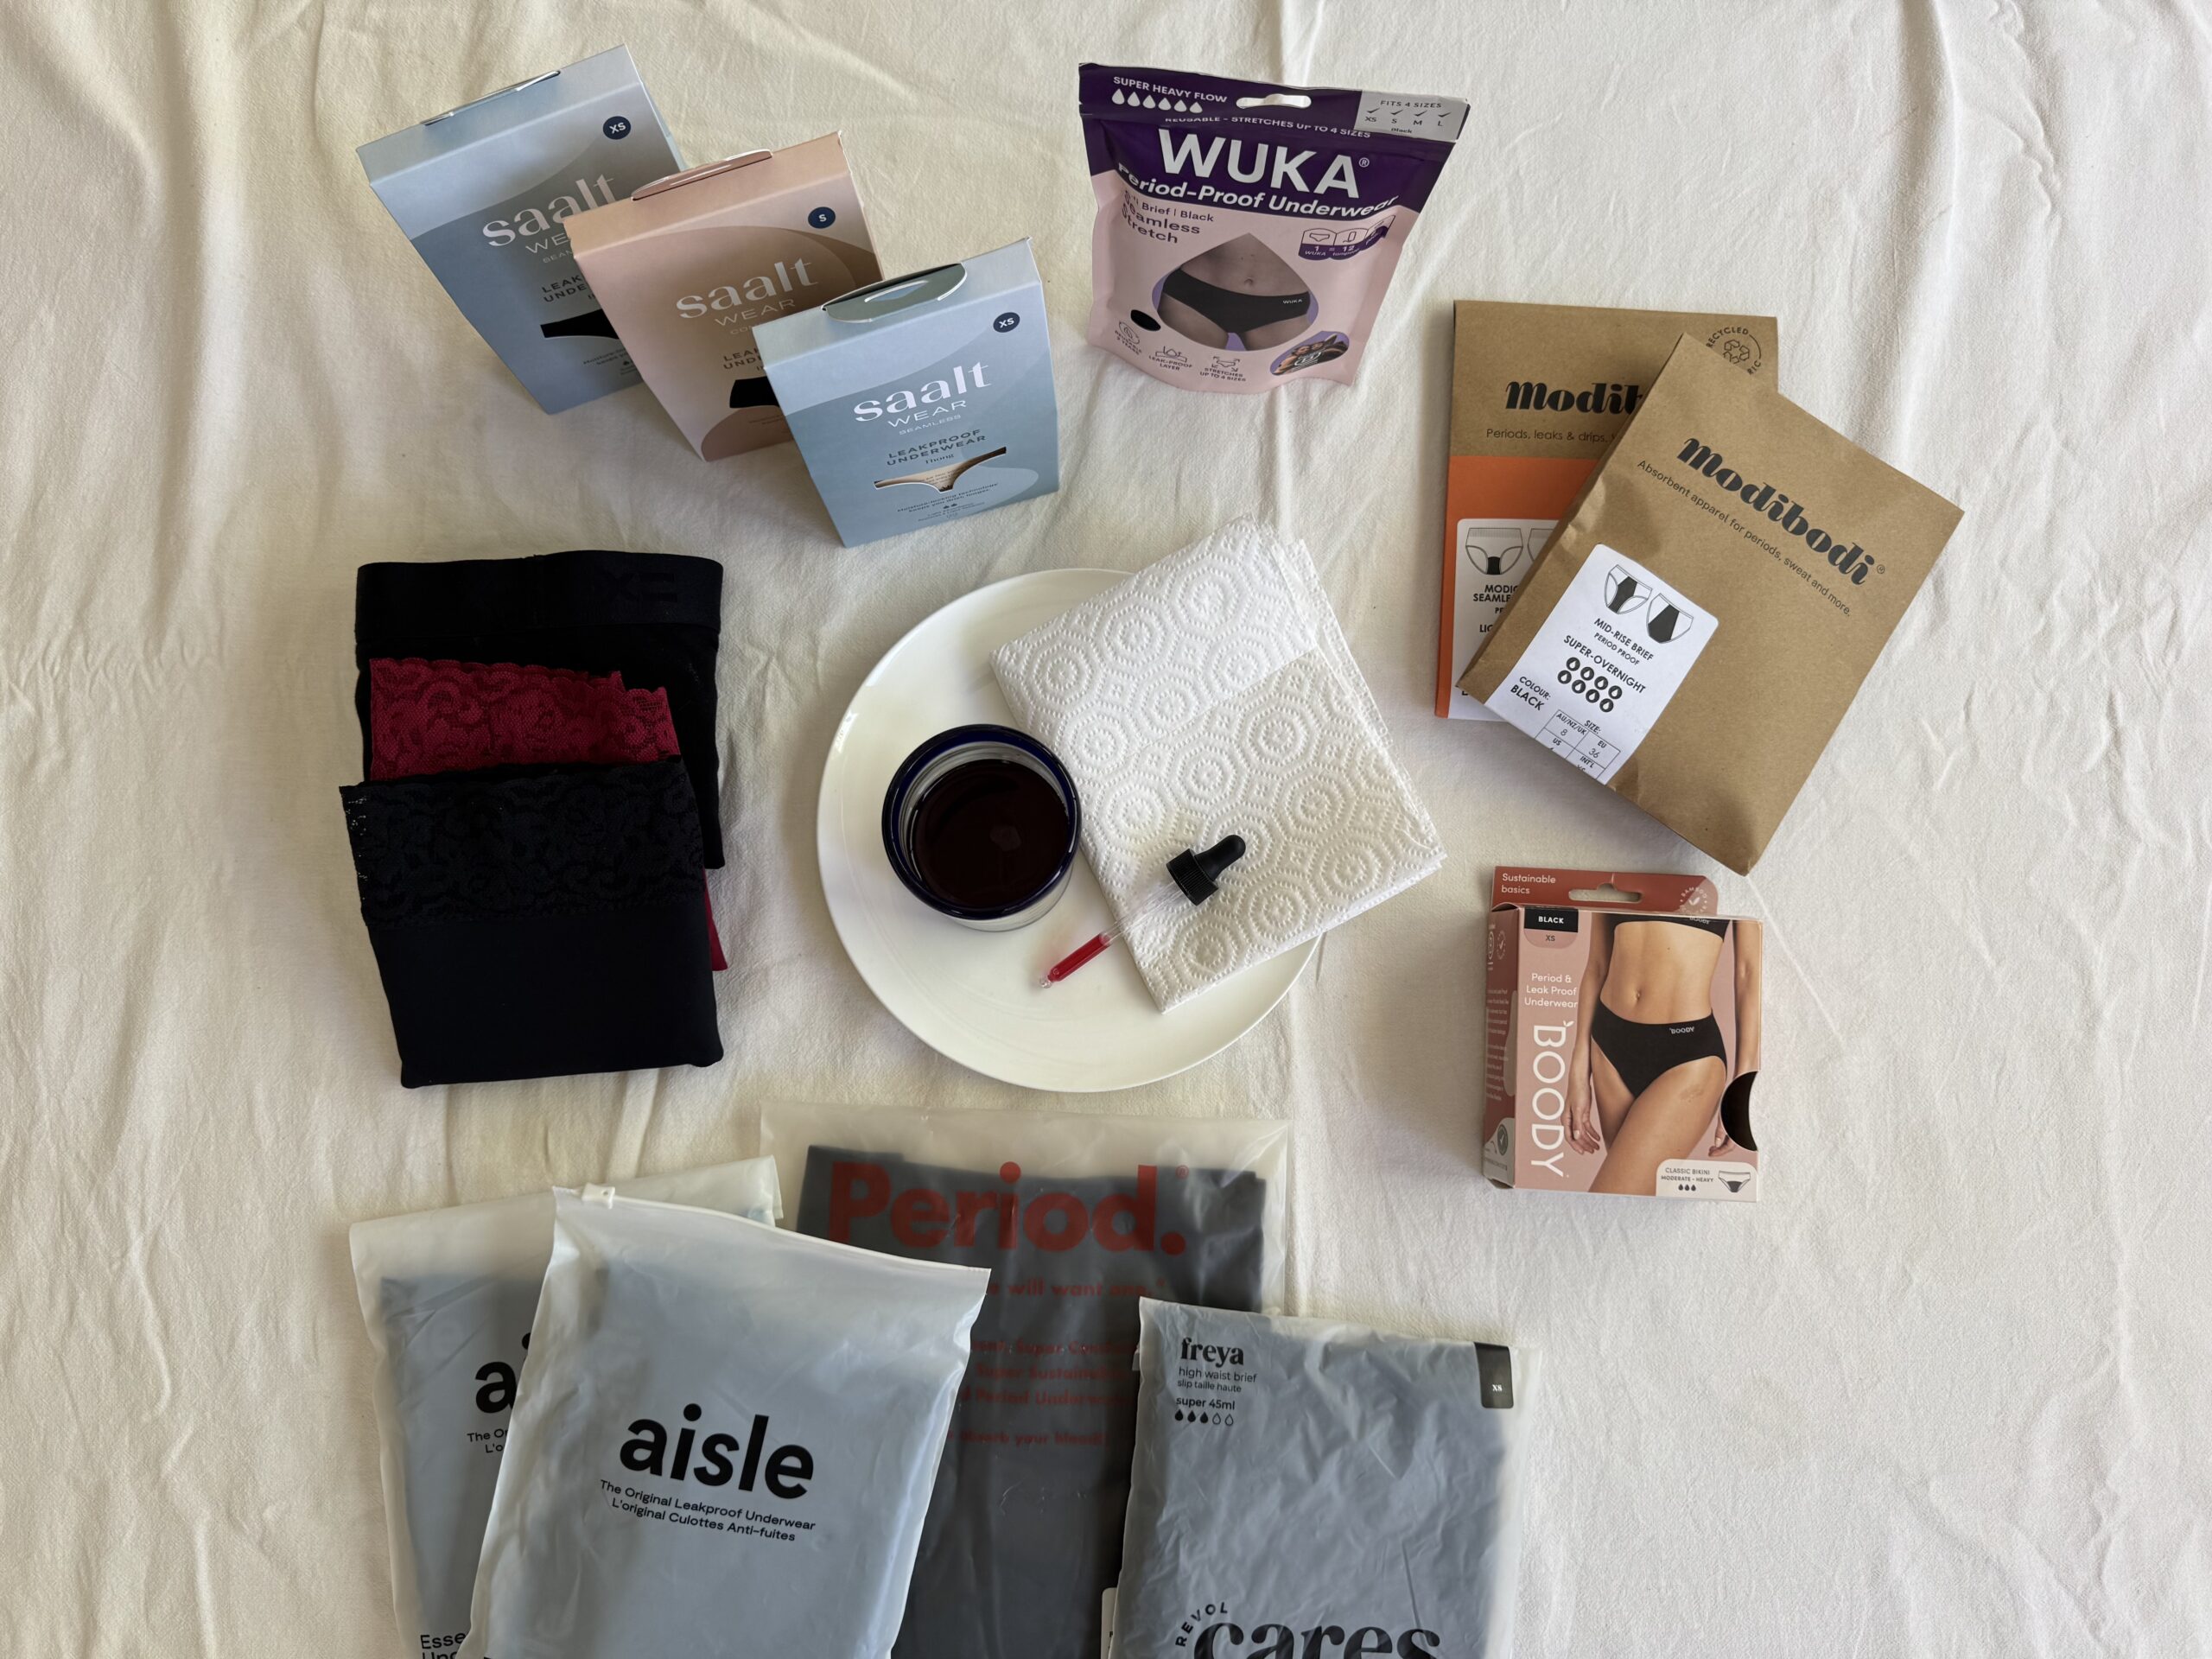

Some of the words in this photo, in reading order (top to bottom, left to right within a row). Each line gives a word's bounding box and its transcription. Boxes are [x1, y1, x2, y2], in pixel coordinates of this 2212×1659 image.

[1113, 76, 1150, 91] SUPER
[1153, 84, 1192, 99] HEAVY
[1194, 92, 1228, 103] FLOW
[609, 121, 626, 135] XS
[1231, 117, 1294, 129] STRETCHES
[1314, 124, 1328, 133] TO
[1340, 129, 1371, 139] SIZES
[482, 174, 616, 247] saalt
[1142, 202, 1172, 215] Brief
[1180, 210, 1214, 222] Black
[1268, 194, 1400, 218] Underwear
[819, 213, 827, 222] S
[676, 257, 818, 319] saalt
[714, 298, 795, 327] WEAR
[999, 317, 1014, 328] XS
[1706, 327, 1750, 348] RECYCLED
[853, 361, 992, 422] saalt
[887, 399, 967, 428] WEAR
[888, 429, 982, 459] LEAKPROOF
[1486, 428, 1531, 441] Periods,
[1534, 429, 1563, 441] leaks
[1567, 431, 1575, 441] &
[1578, 430, 1608, 446] drips.
[887, 435, 987, 466] UNDERWEAR
[1637, 460, 1690, 499] Absorbent
[1690, 492, 1731, 524] apparel
[1729, 518, 1745, 533] for
[1743, 531, 1782, 562] periods,
[1783, 557, 1811, 582] sweat
[1810, 579, 1829, 596] and
[1827, 594, 1851, 617] more.
[1593, 618, 1632, 647] MID-RISE
[1630, 642, 1654, 661] BRIEF
[1593, 632, 1618, 652] PERIOD
[1617, 646, 1640, 666] PROOF
[1563, 634, 1647, 694] SUPER-OVERNIGHT
[1510, 684, 1545, 711] BLACK
[1519, 676, 1552, 701] COLOUR:
[1556, 713, 1587, 735] AU/NZ/UK
[1560, 728, 1568, 737] 8
[1584, 719, 1602, 734] SIZE:
[1552, 738, 1562, 747] US
[1588, 747, 1600, 759] 36
[1598, 741, 1607, 749] EU
[1501, 885, 1530, 894] basics
[1502, 873, 1556, 884] Sustainable
[1531, 973, 1562, 982] Period
[1565, 975, 1572, 983] &
[1526, 985, 1548, 994] Leak
[1551, 986, 1577, 995] Proof
[1524, 997, 1578, 1008] Underwear
[1180, 1337, 1244, 1369] freya
[1179, 1366, 1202, 1379] high
[1205, 1370, 1231, 1381] waist
[1234, 1370, 1258, 1382] brief
[1177, 1379, 1192, 1389] slip
[1194, 1381, 1215, 1390] taille
[1217, 1382, 1242, 1393] haute
[1176, 1397, 1206, 1408] super
[1209, 1398, 1236, 1410] 45ml
[467, 1432, 491, 1443] The
[620, 1403, 815, 1501] aisle
[601, 1479, 622, 1495] The
[625, 1487, 671, 1506] Original
[674, 1498, 743, 1519] Leakproof
[745, 1510, 817, 1530] Underwear
[612, 1497, 665, 1520] L'original
[669, 1513, 724, 1530] Culottes
[727, 1522, 796, 1542] Anti-fuites
[1175, 1601, 1228, 1647] REVOL
